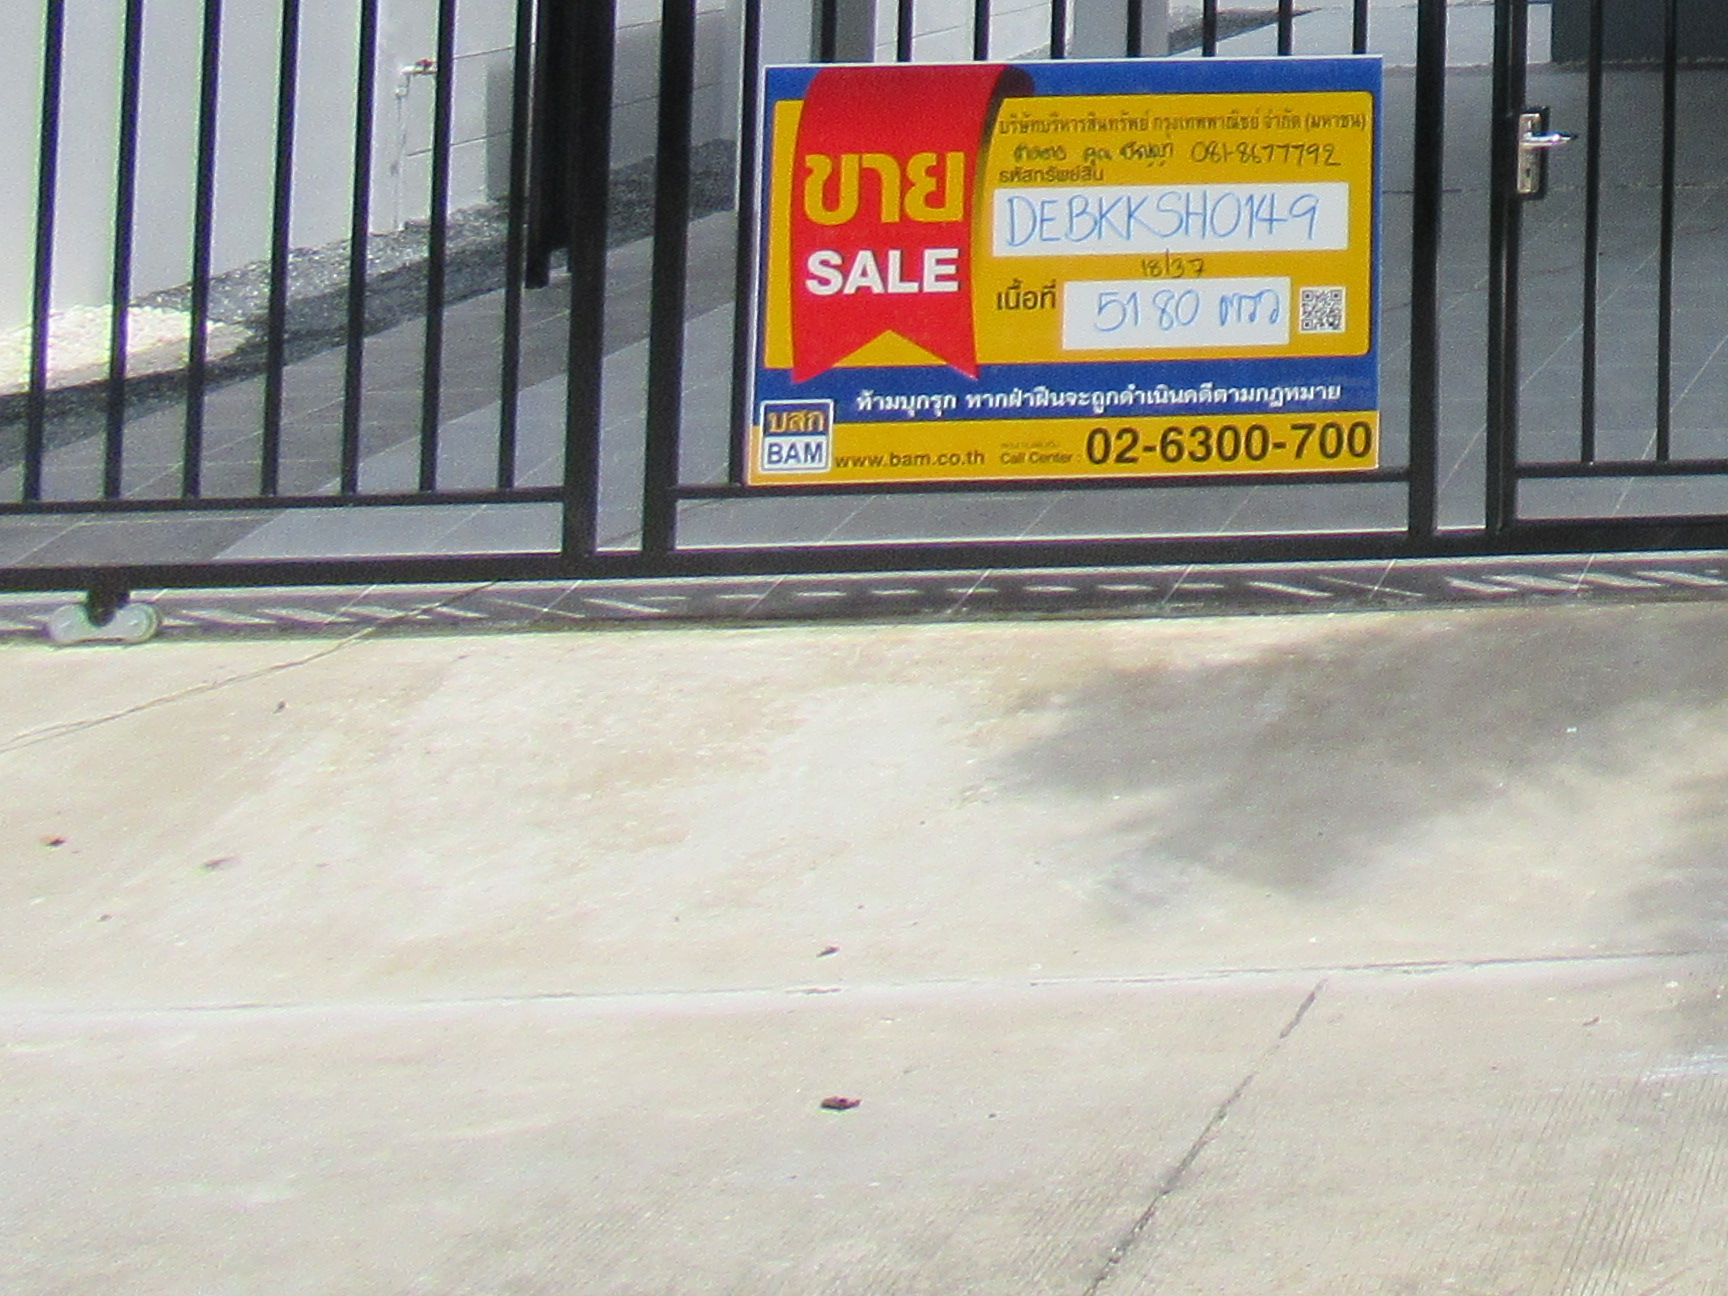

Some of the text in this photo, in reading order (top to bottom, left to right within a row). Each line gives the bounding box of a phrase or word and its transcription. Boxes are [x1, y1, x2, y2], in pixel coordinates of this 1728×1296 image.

[804, 151, 965, 226] ขาย
[805, 248, 960, 295] SALE
[997, 278, 1056, 310] เนื้อที่
[857, 388, 956, 418] ห้ามบุกรุก
[768, 409, 826, 434] บสก
[767, 441, 824, 465] BAM
[1086, 421, 1374, 465] 02-6300-700
[835, 450, 985, 469] www.bam.co.th
